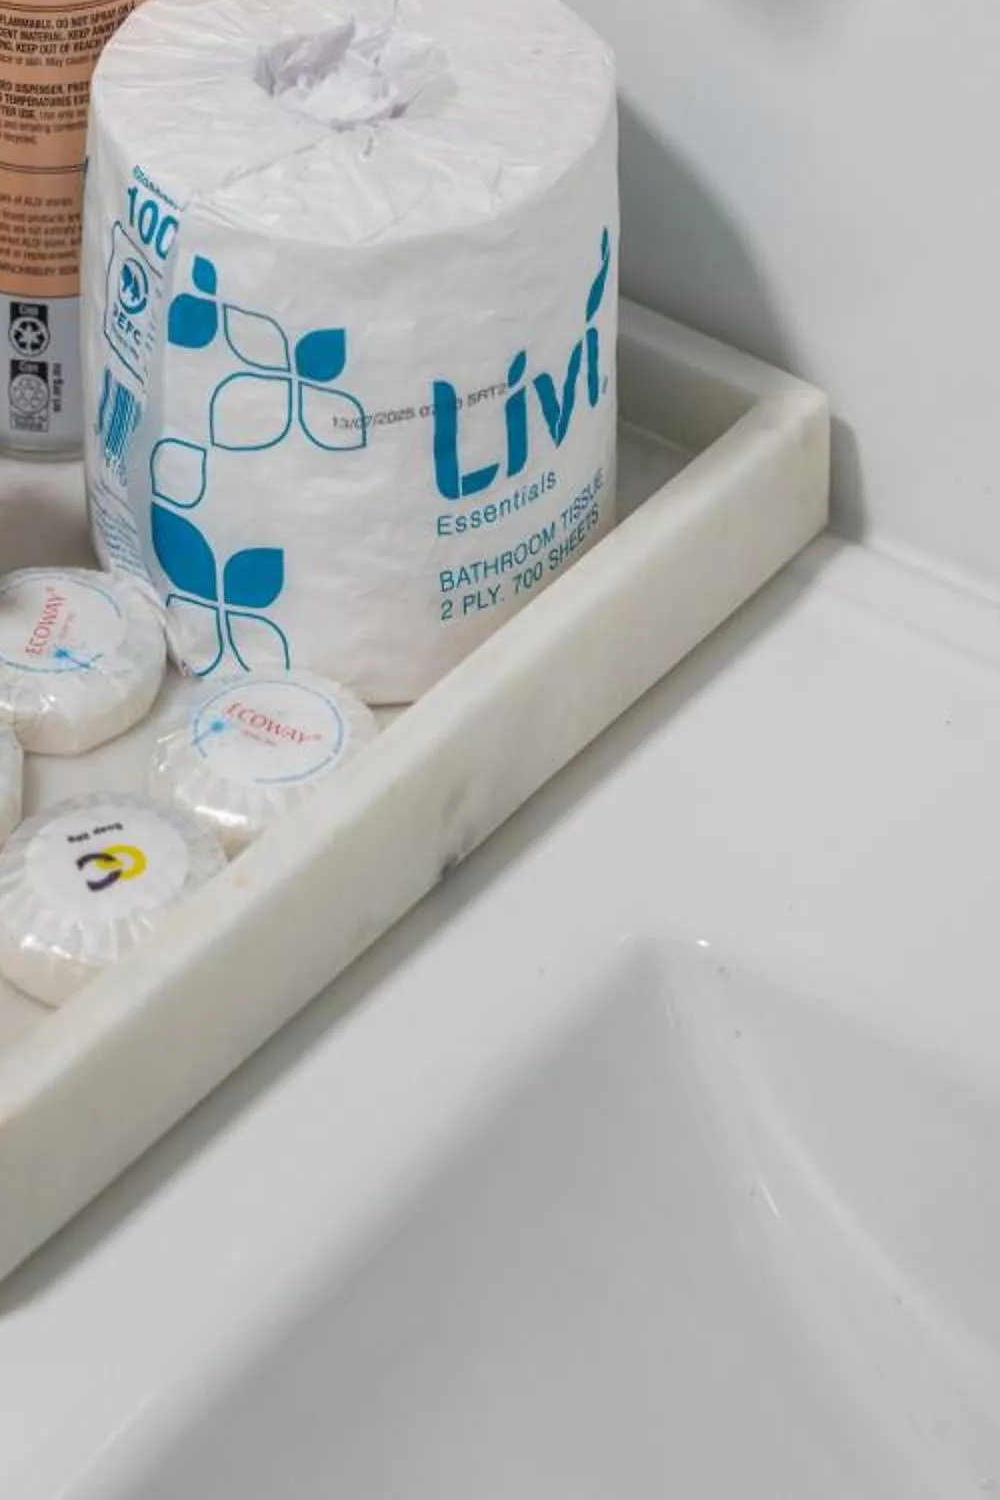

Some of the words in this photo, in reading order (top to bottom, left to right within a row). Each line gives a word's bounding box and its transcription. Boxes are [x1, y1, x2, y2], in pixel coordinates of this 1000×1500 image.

[15, 41, 39, 54] KEEP
[40, 43, 58, 55] OUT
[59, 42, 70, 54] OF
[432, 226, 610, 501] Livi
[436, 470, 558, 538] Essentials
[439, 520, 557, 593] BATHROOM
[559, 466, 605, 530] TISSUE
[440, 599, 454, 621] 2
[511, 560, 544, 594] 700
[547, 502, 600, 572] SHEETS
[25, 588, 70, 658] ECOWAY
[225, 700, 316, 746] ECOWAY
